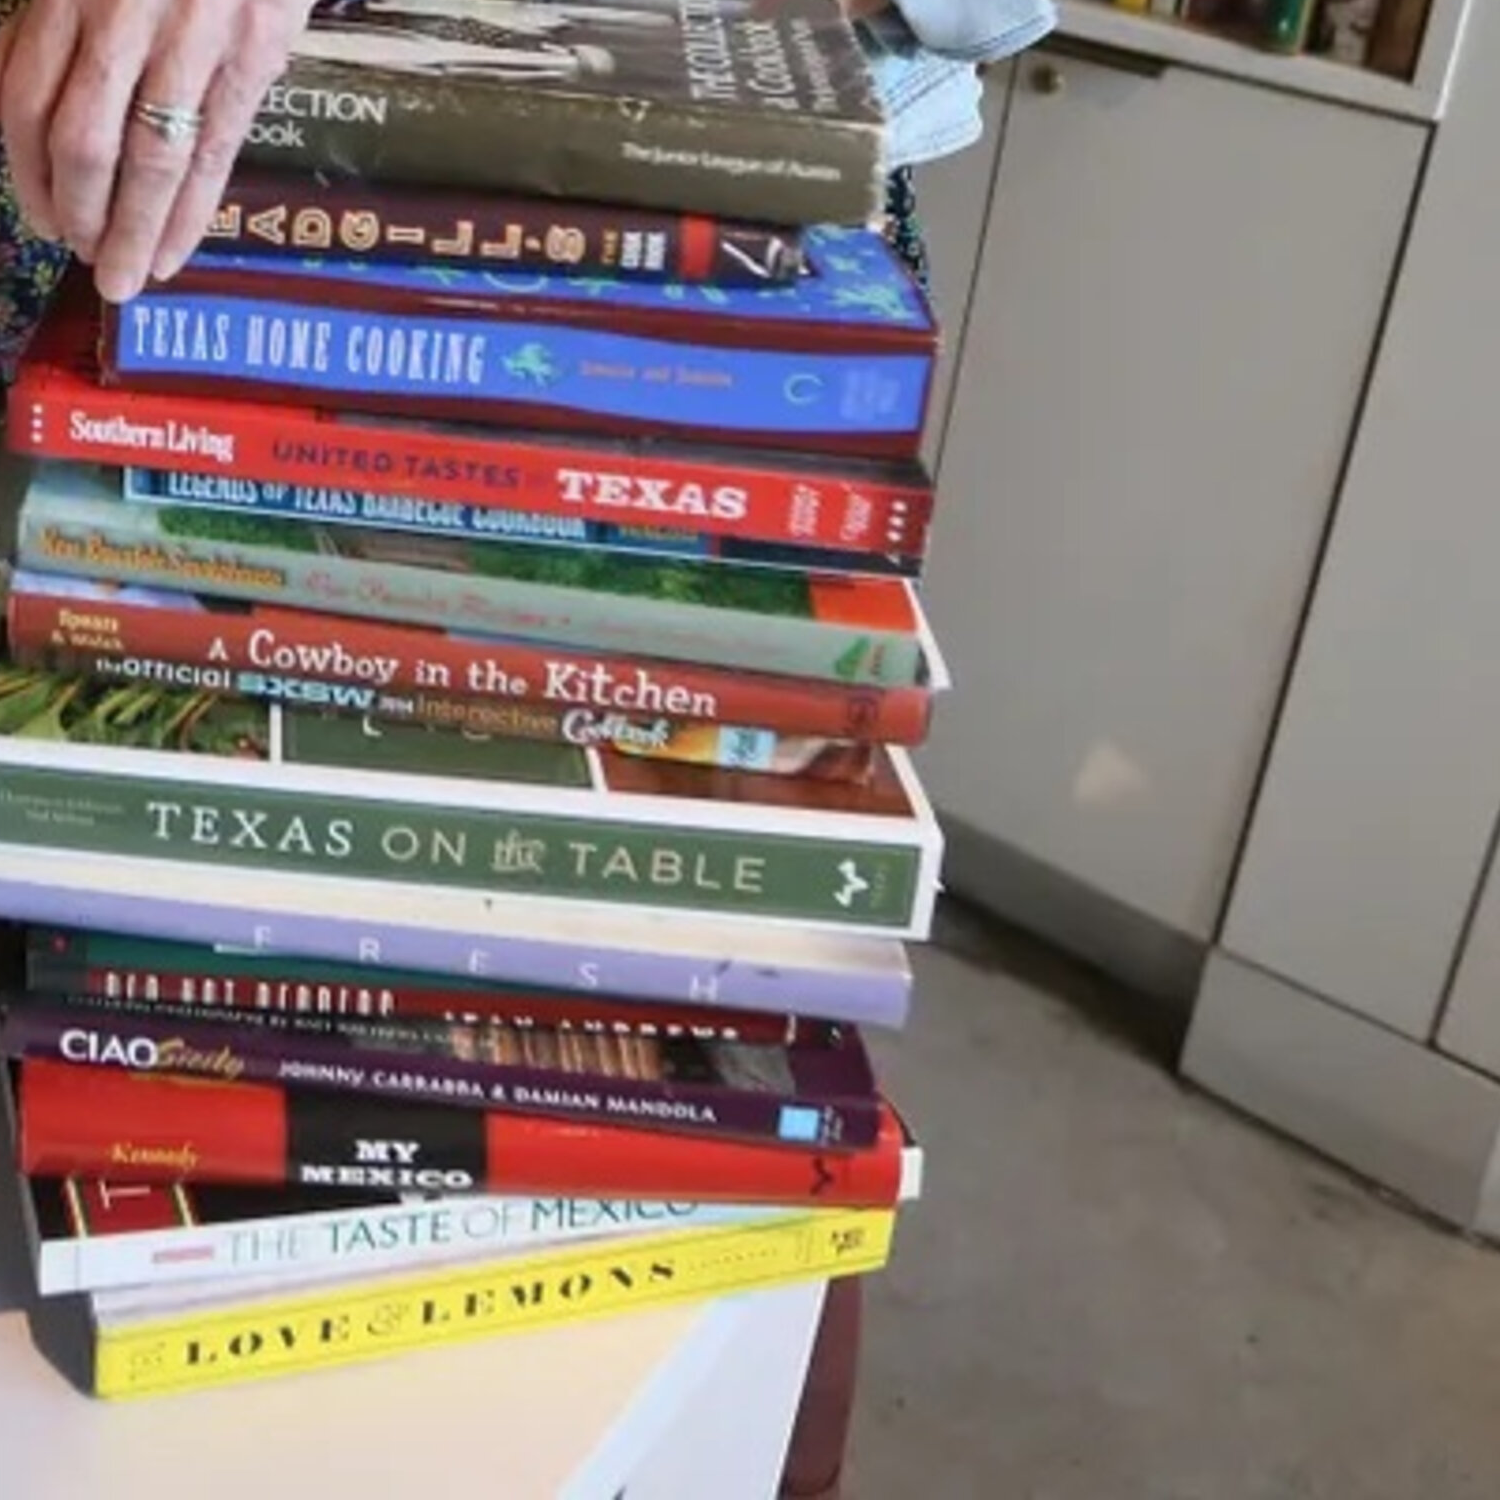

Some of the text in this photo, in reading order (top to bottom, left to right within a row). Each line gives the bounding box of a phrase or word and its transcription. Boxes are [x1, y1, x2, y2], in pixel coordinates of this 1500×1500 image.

[262, 87, 388, 125] ECTION
[247, 122, 306, 148] ook
[701, 152, 762, 177] League
[787, 161, 842, 181] Austin
[205, 204, 586, 265] EADGILL'S
[133, 306, 488, 386] TEXAS HOME COOKING
[70, 411, 236, 464] Southern Living
[271, 440, 521, 491] UNITED TASTES
[291, 482, 357, 517] TEXAS
[556, 467, 748, 521] TEXAS
[207, 627, 718, 718] A Cowboy in the Kitchen
[236, 669, 378, 711] SXSW
[147, 801, 766, 894] TEXAS ON the TABLE
[59, 1028, 158, 1069] CIAO
[275, 1059, 365, 1086] JOHNNY
[372, 1072, 484, 1098] CARRABBA
[513, 1085, 600, 1110] DAMIAN
[606, 1096, 717, 1123] MANDOLA
[111, 1140, 200, 1169] Kennedy
[301, 1163, 474, 1190] MEXICO
[354, 1139, 420, 1163] MY
[229, 1230, 300, 1266] THE
[329, 1210, 452, 1256] TASTE
[462, 1204, 516, 1239] OF
[186, 1314, 352, 1366] LOVE
[419, 1261, 676, 1330] LEMONS
